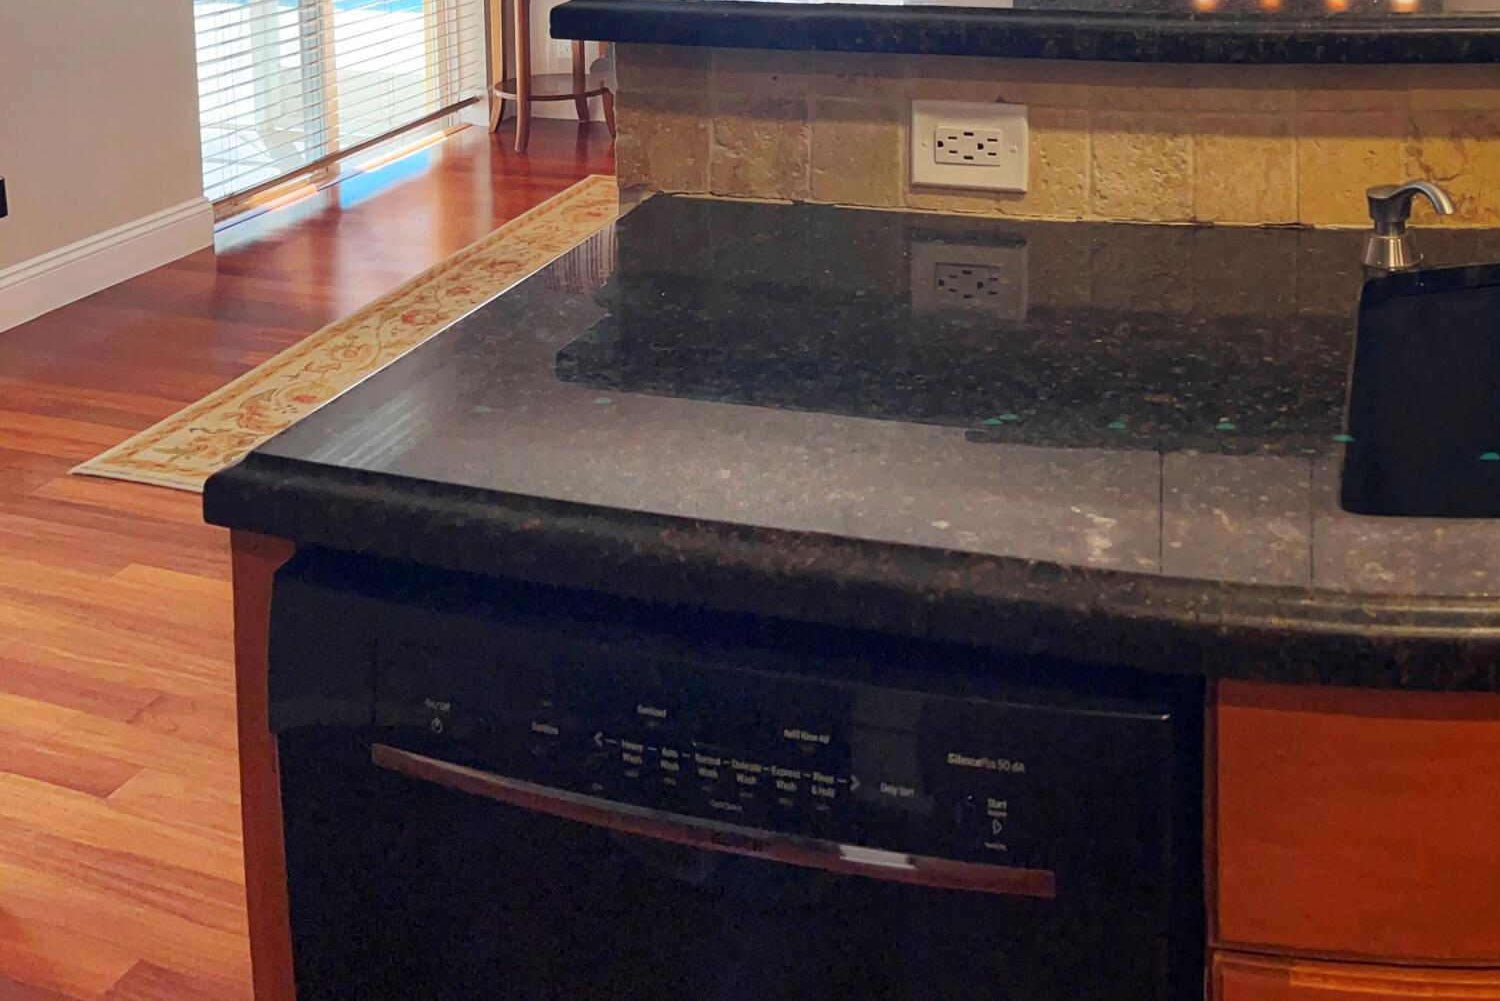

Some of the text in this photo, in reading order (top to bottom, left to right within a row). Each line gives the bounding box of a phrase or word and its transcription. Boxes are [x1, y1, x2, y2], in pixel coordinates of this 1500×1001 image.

[997, 758, 1010, 771] 50
[771, 765, 801, 779] Express
[736, 773, 757, 785] Wash
[776, 780, 797, 792] Wash
